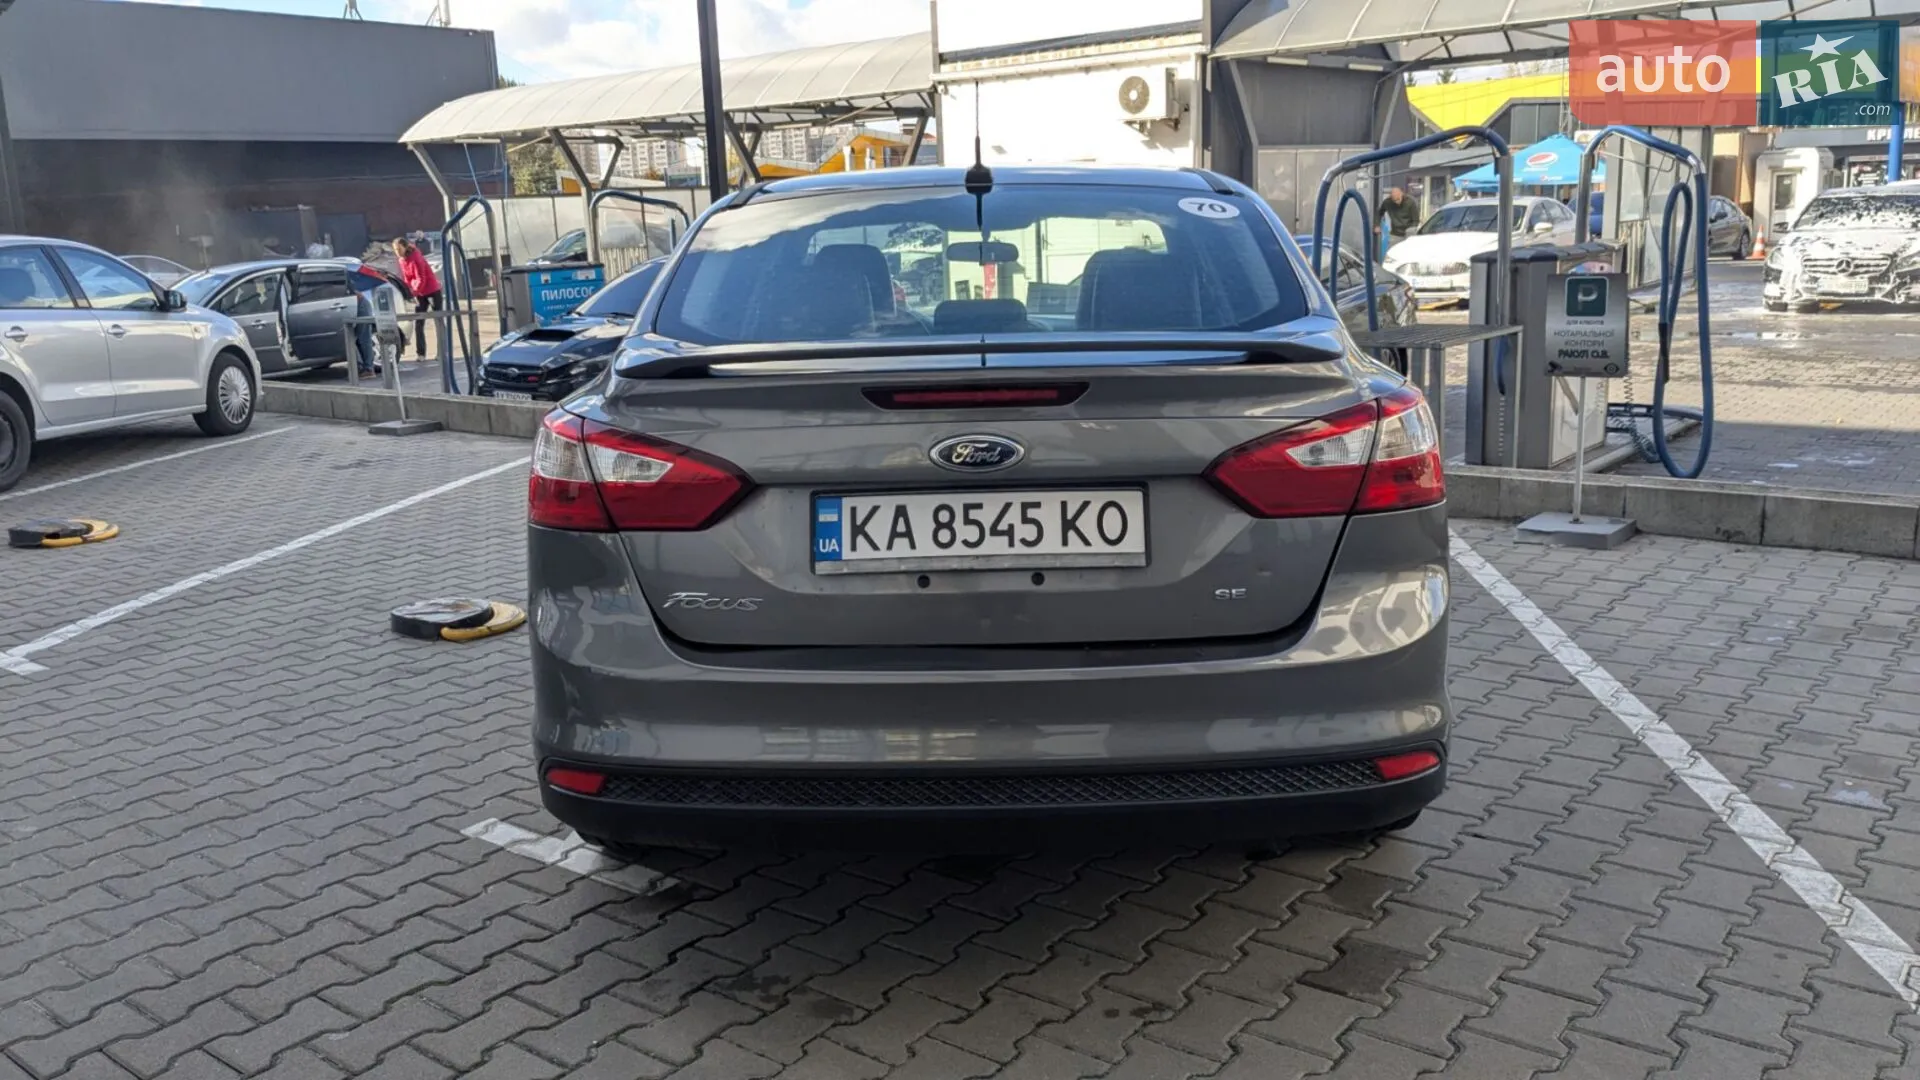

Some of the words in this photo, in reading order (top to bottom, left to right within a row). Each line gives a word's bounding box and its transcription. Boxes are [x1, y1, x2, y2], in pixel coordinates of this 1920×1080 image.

[1188, 201, 1227, 213] 70
[1577, 283, 1599, 312] P
[952, 442, 1001, 464] Ford
[819, 538, 840, 553] UA
[850, 504, 917, 553] KA
[931, 501, 1045, 549] 8545
[1060, 499, 1129, 547] KO
[1214, 588, 1247, 600] SE
